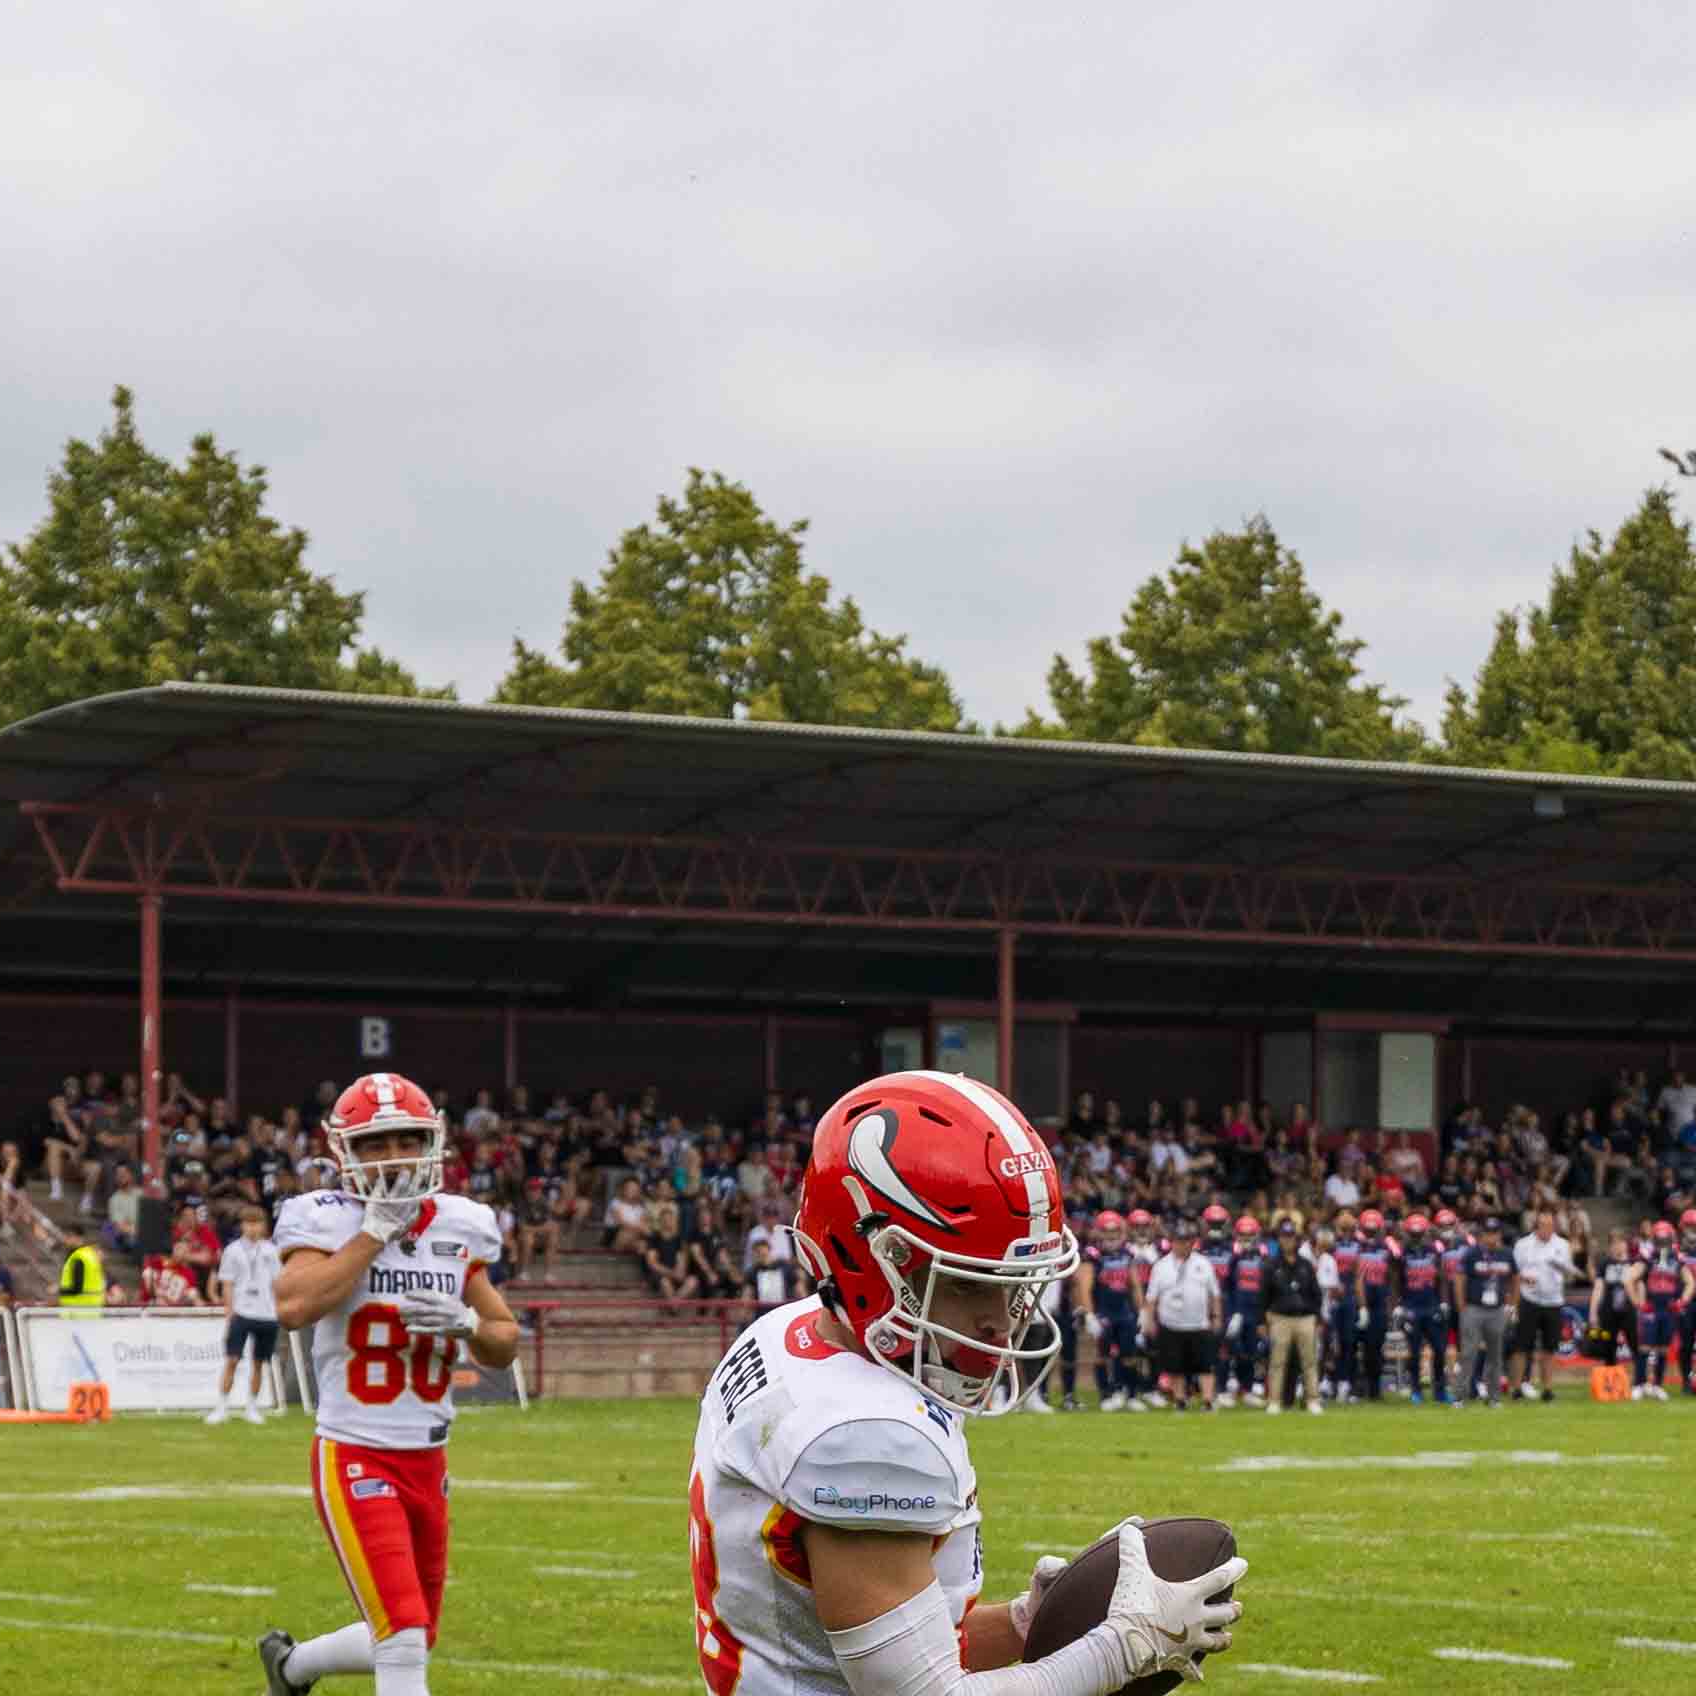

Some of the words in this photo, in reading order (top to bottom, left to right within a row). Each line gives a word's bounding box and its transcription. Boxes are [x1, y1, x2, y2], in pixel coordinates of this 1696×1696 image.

[360, 1017, 389, 1056] B
[999, 1152, 1051, 1177] GAZI
[347, 1303, 454, 1405] 80
[716, 1337, 768, 1425] PEREZ
[73, 1386, 105, 1419] 20
